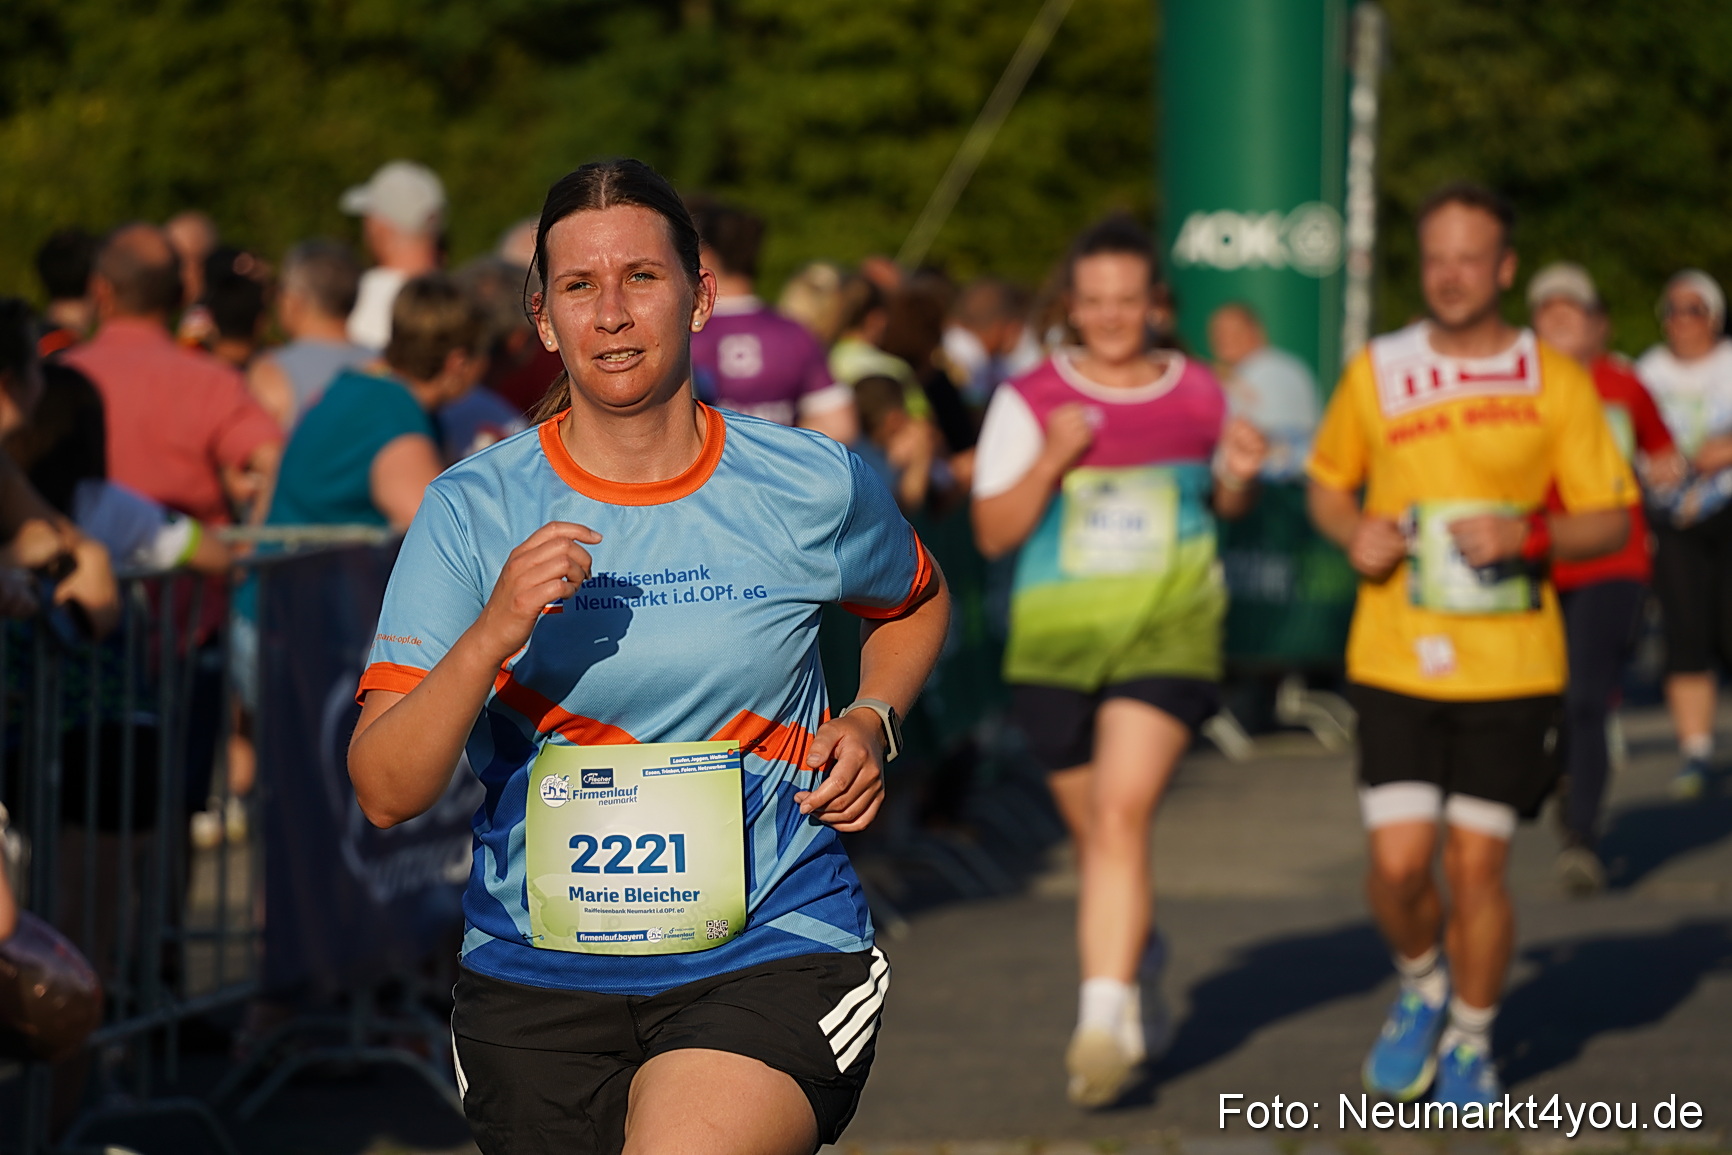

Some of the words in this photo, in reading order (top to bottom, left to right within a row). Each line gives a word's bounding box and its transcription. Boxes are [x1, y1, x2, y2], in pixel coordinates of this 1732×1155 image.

[583, 565, 711, 589] aiffeisenbank
[575, 590, 668, 611] Neumarkt
[674, 584, 738, 605] i.d.OPf.
[743, 585, 768, 600] eG
[573, 785, 638, 800] Firmenlauf
[599, 796, 638, 806] neumarkt
[569, 834, 686, 874] 2221
[569, 886, 619, 902] Marie
[624, 887, 700, 903] Bleicher
[580, 933, 644, 942] firmenlauf.bayern
